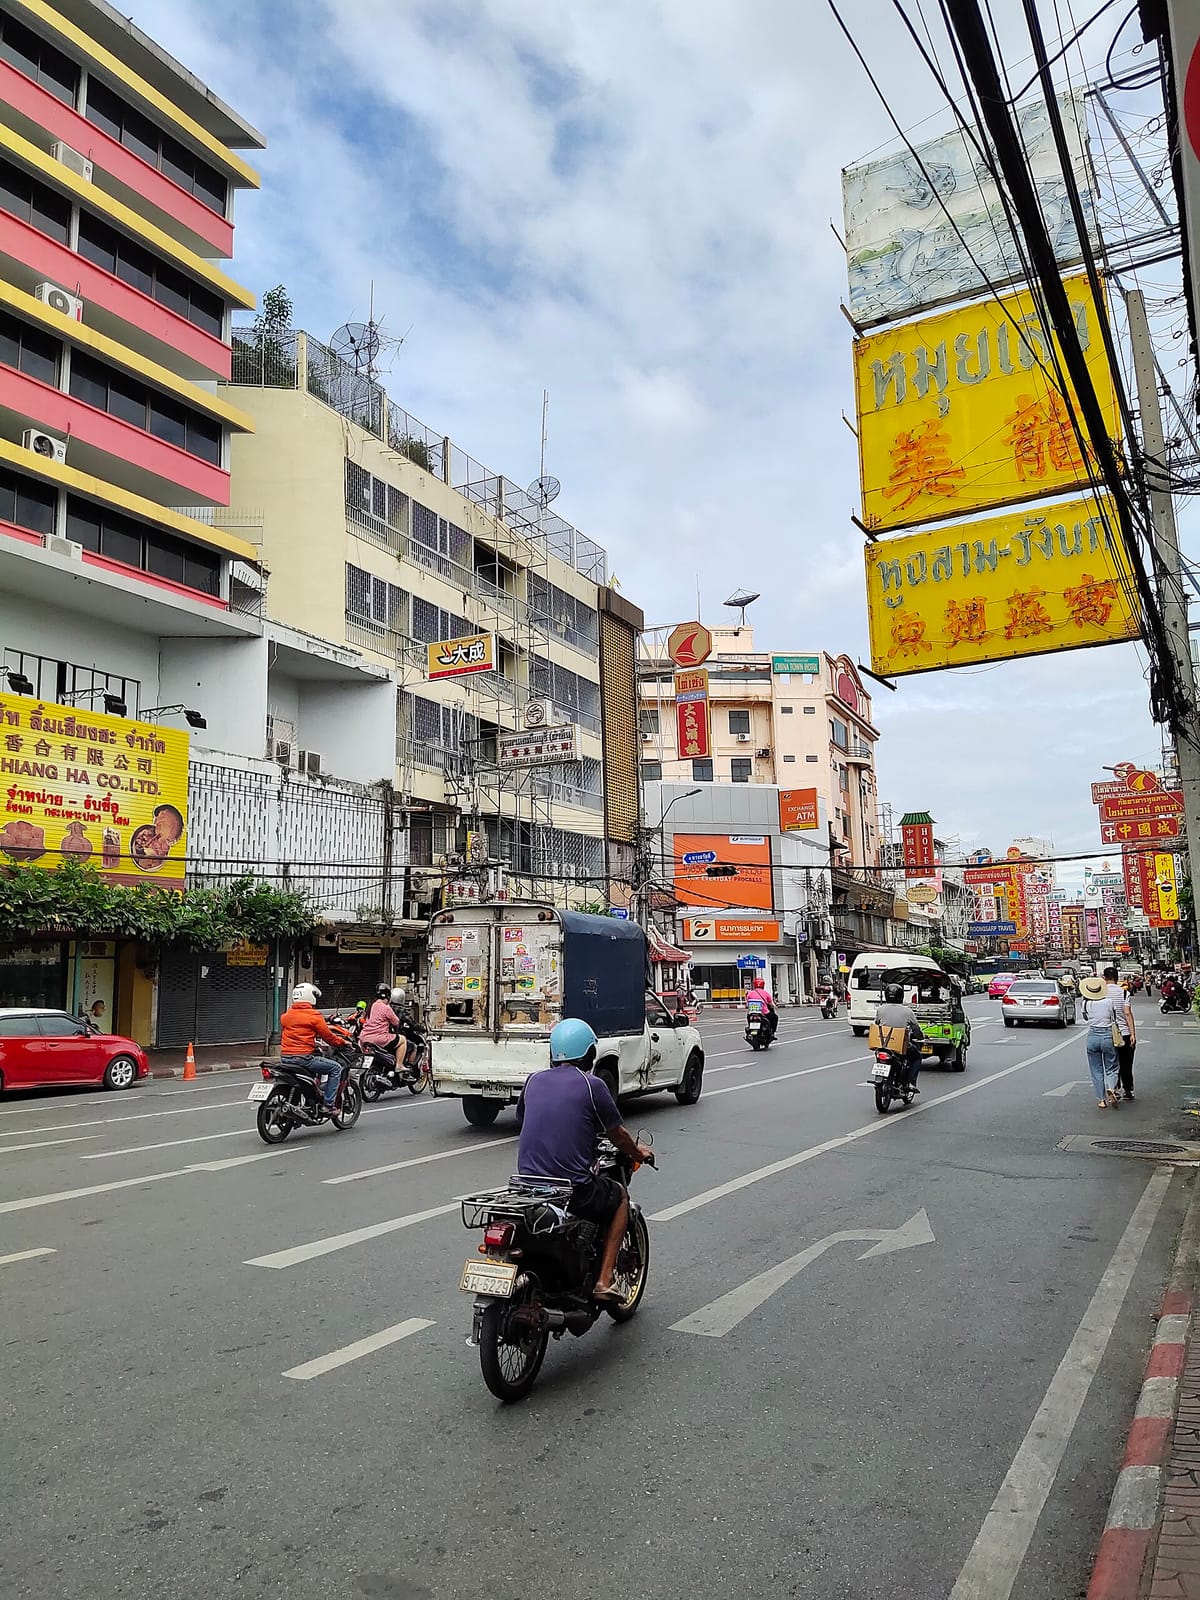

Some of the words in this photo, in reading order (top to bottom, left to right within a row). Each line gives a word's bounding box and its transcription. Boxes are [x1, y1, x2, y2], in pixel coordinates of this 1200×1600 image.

[453, 642, 486, 664] 大成
[126, 729, 166, 754] จำกัด
[5, 734, 153, 775] 香合有限公司
[1, 758, 59, 780] HIANG
[66, 768, 90, 785] HA
[796, 811, 815, 821] ATM
[1119, 820, 1174, 839] 中國城
[921, 828, 930, 874] HOTEL
